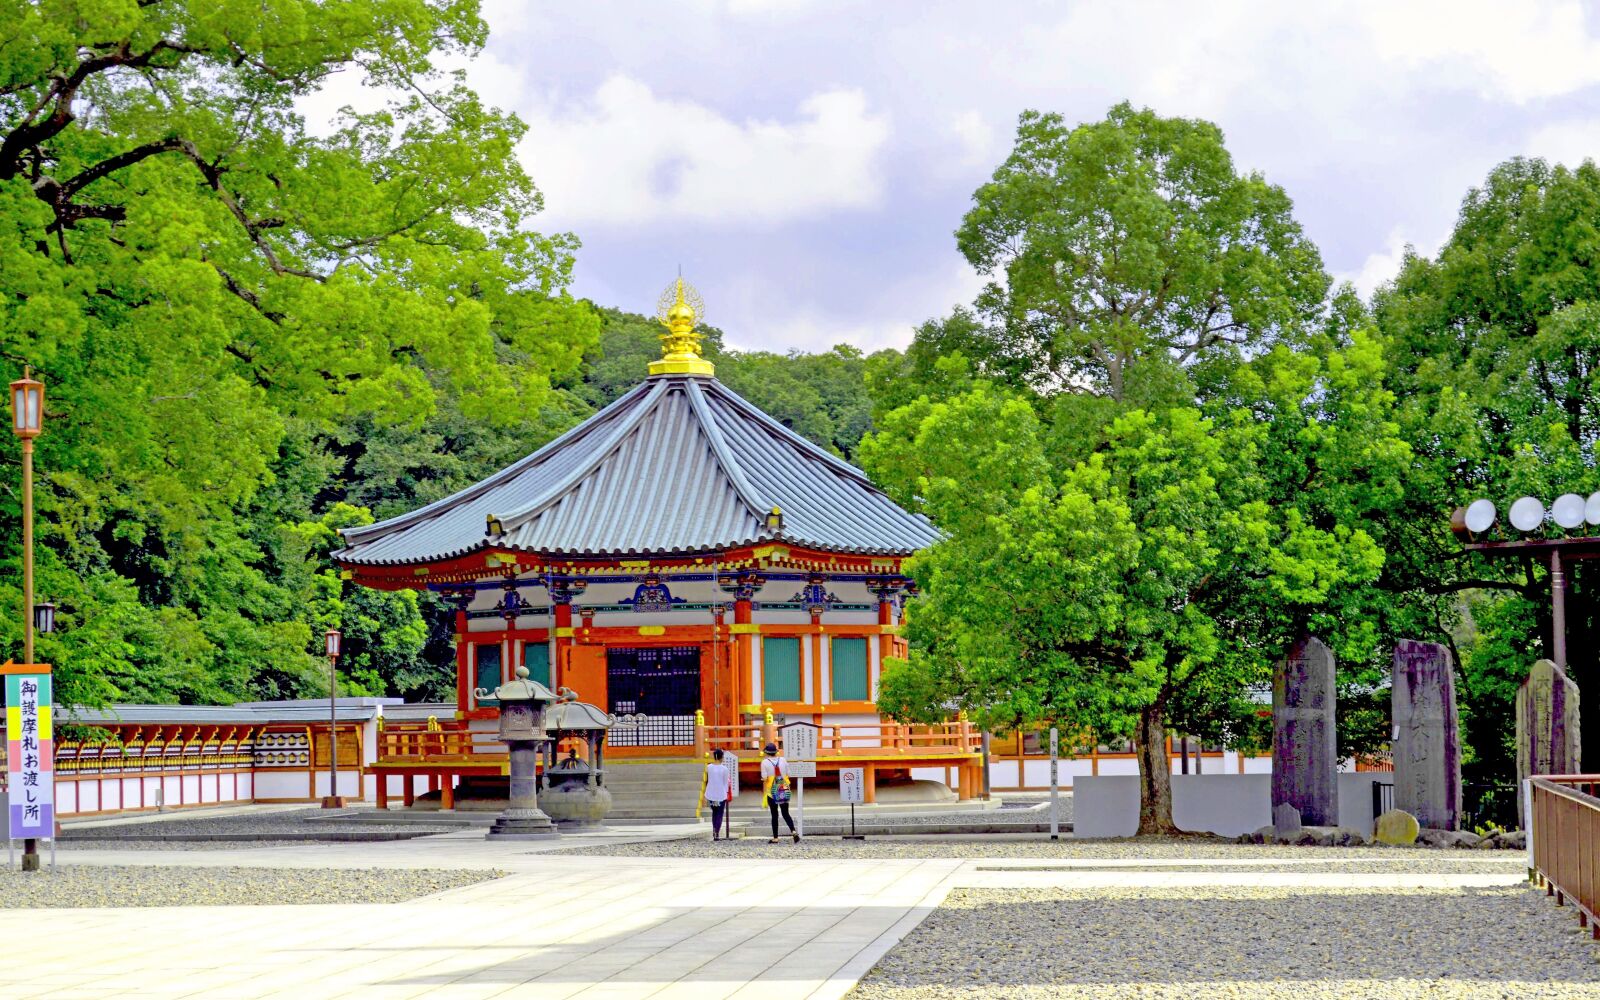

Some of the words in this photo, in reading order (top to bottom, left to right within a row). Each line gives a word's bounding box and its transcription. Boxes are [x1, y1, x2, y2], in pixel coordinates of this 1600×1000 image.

[20, 680, 39, 821] 御護摩札お渡し所
